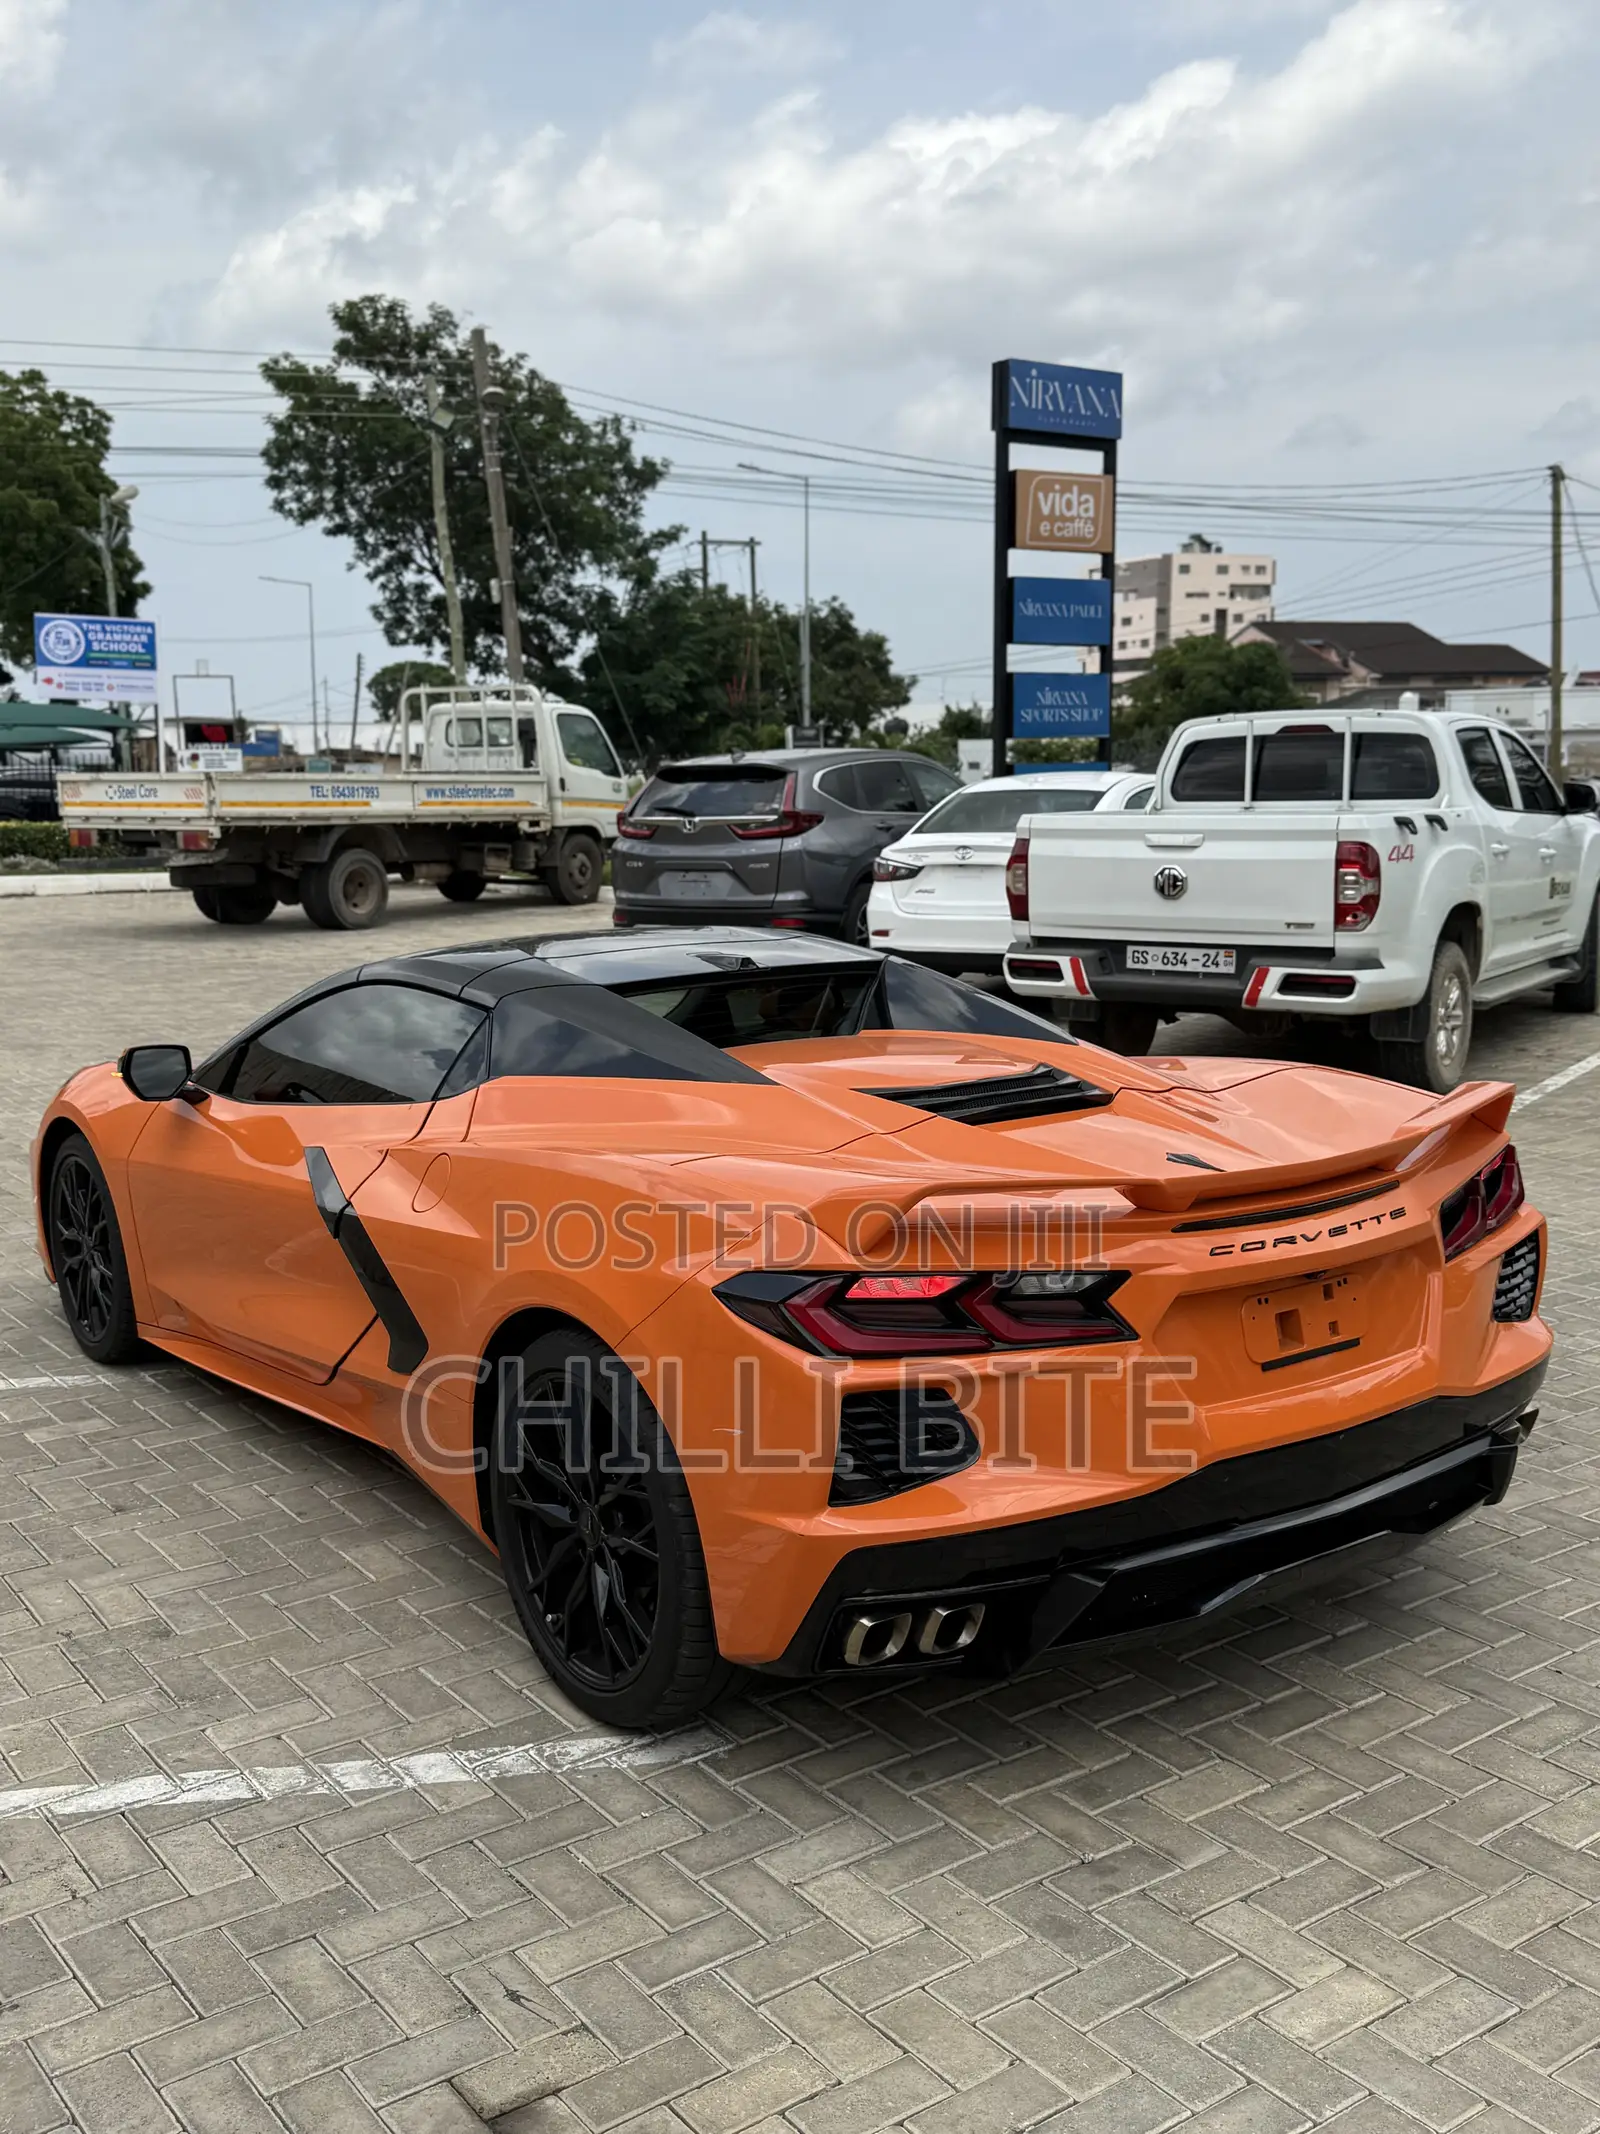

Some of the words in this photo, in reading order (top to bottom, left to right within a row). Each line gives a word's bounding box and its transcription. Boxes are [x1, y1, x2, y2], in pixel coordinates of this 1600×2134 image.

[1037, 484, 1095, 518] vida
[1040, 520, 1050, 537] e
[81, 622, 101, 632] THE
[104, 623, 153, 634] VICTORIA
[87, 631, 148, 644] GRAMMAR
[91, 641, 146, 653] SCHOOL
[1020, 707, 1069, 724] SPORTS
[1069, 707, 1104, 723] SHOP
[117, 783, 137, 800] Steel
[310, 784, 329, 799] TEL:
[1387, 843, 1415, 863] 44
[1154, 867, 1186, 898] MG
[1131, 950, 1150, 965] GS
[1209, 1206, 1408, 1257] CORVETTE
